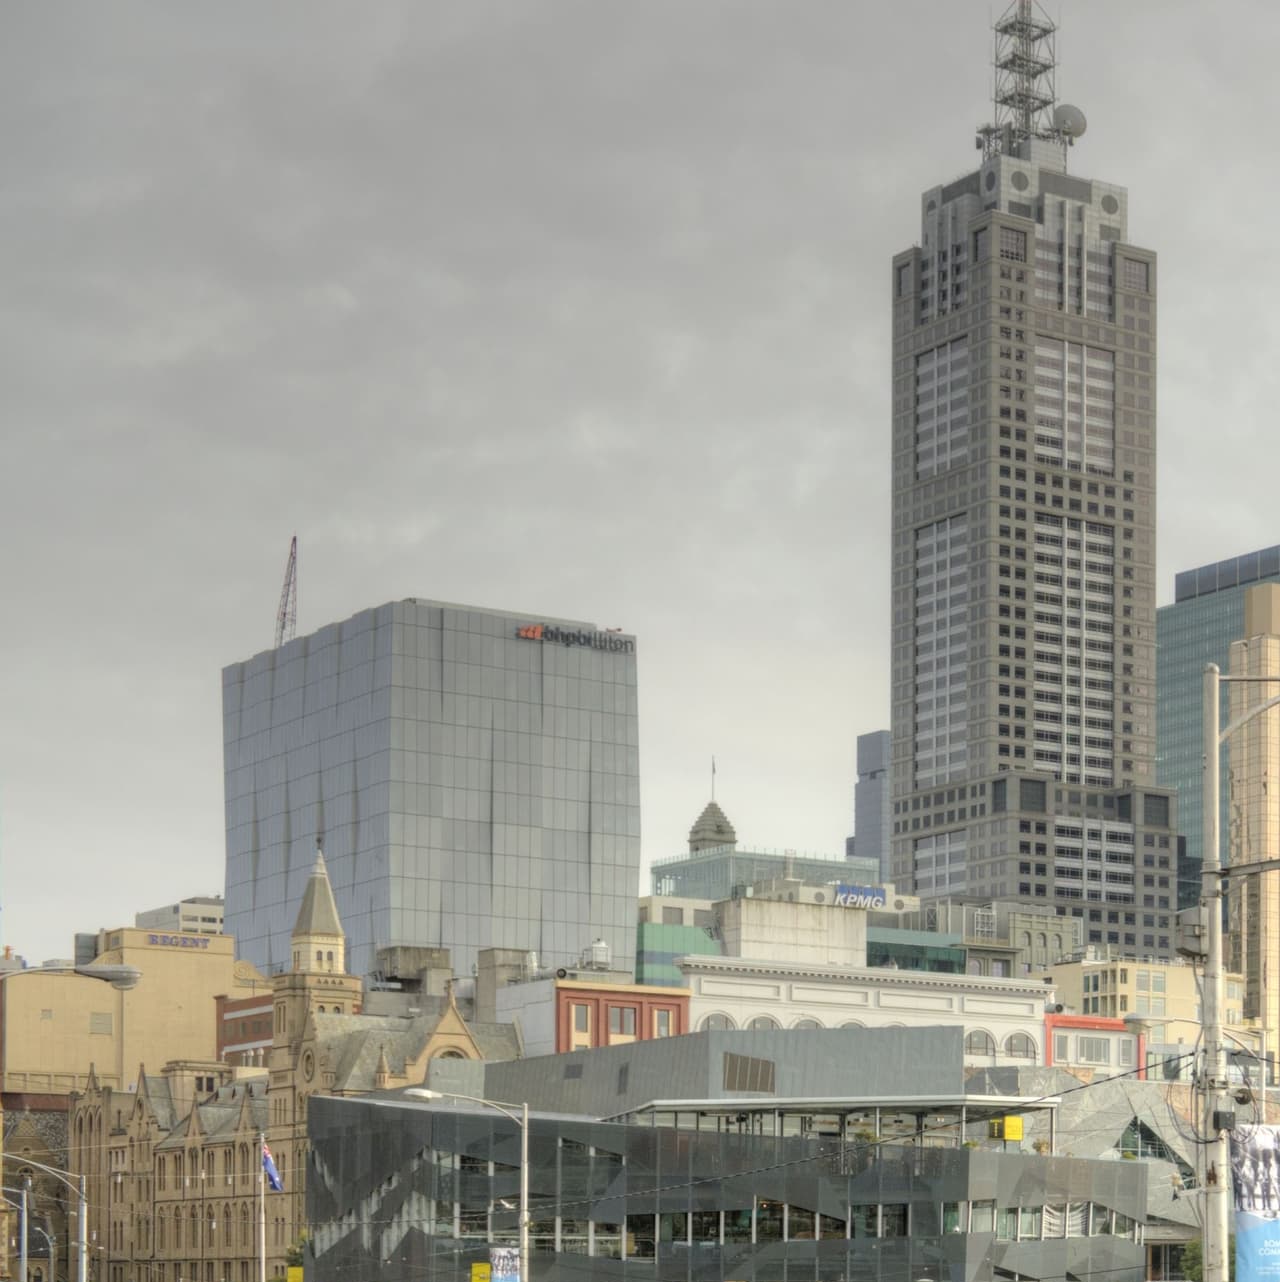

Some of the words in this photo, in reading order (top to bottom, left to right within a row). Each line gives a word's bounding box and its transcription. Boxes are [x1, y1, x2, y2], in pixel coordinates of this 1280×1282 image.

[543, 624, 634, 653] bhpbilliton
[834, 893, 883, 909] KPMG
[147, 933, 210, 949] REGENT
